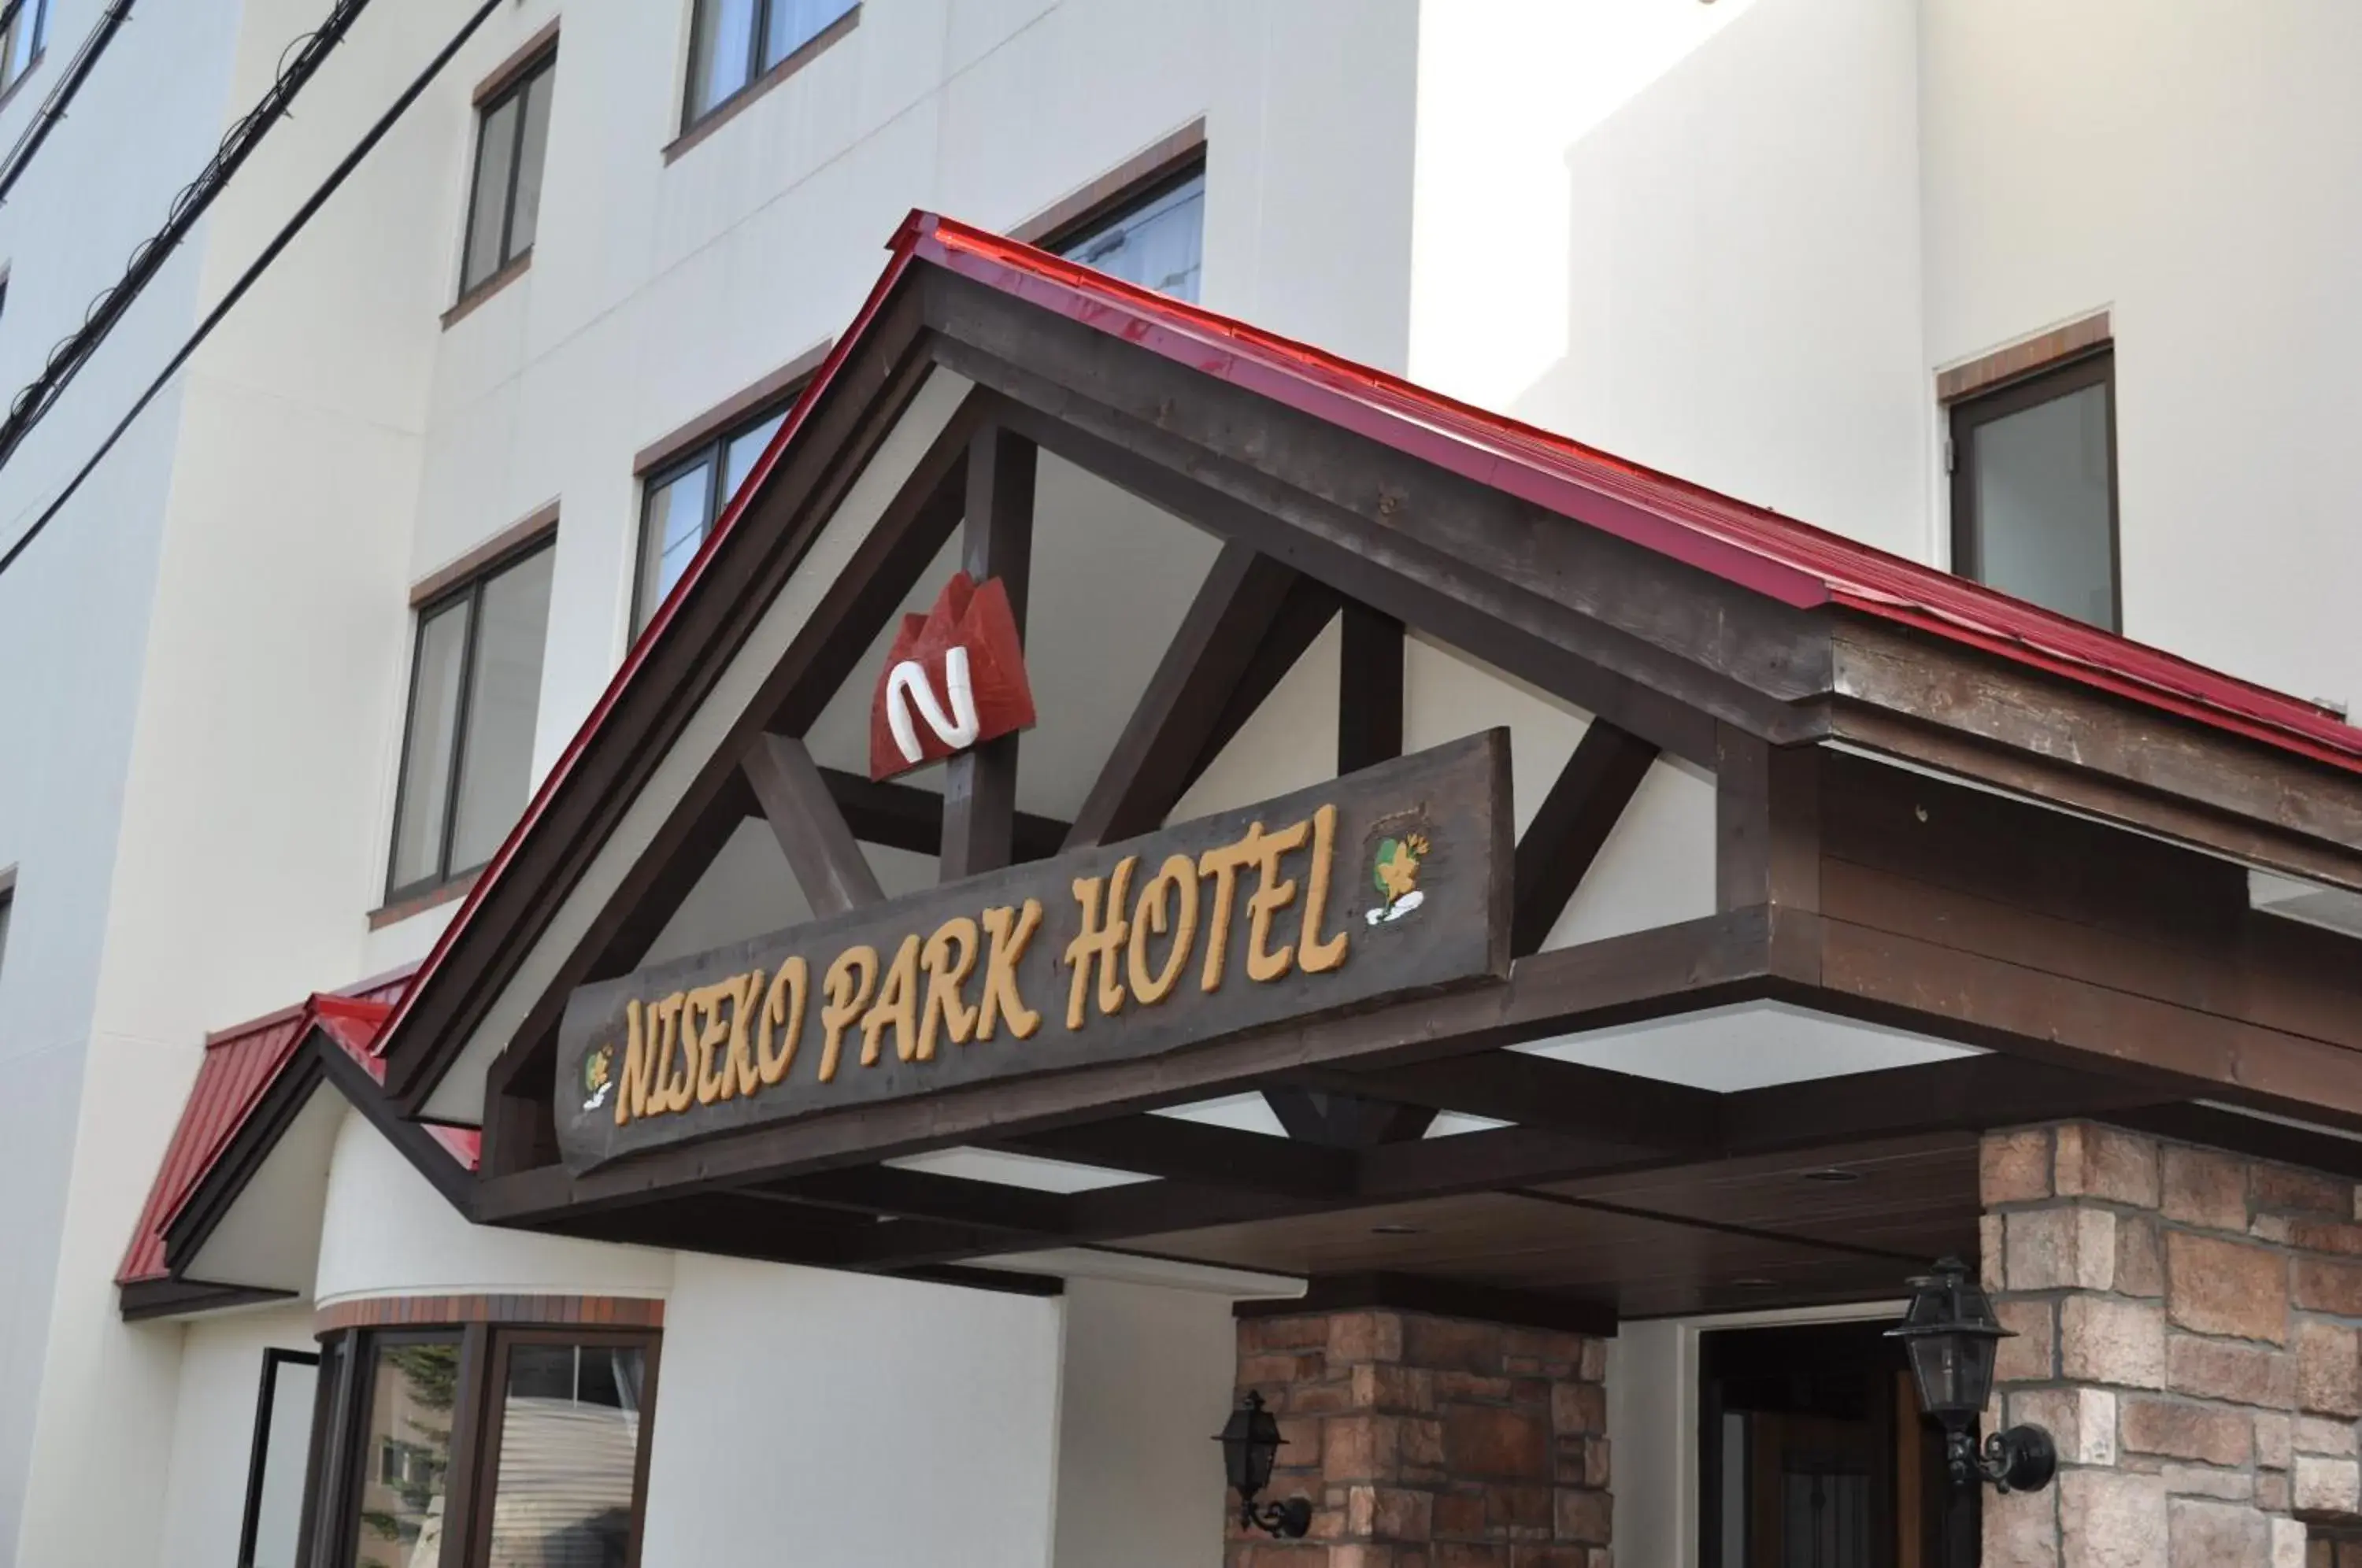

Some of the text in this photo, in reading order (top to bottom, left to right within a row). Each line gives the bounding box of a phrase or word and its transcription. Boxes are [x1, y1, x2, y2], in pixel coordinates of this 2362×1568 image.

[615, 804, 1349, 1126] NISEKO PARK HOTEL
